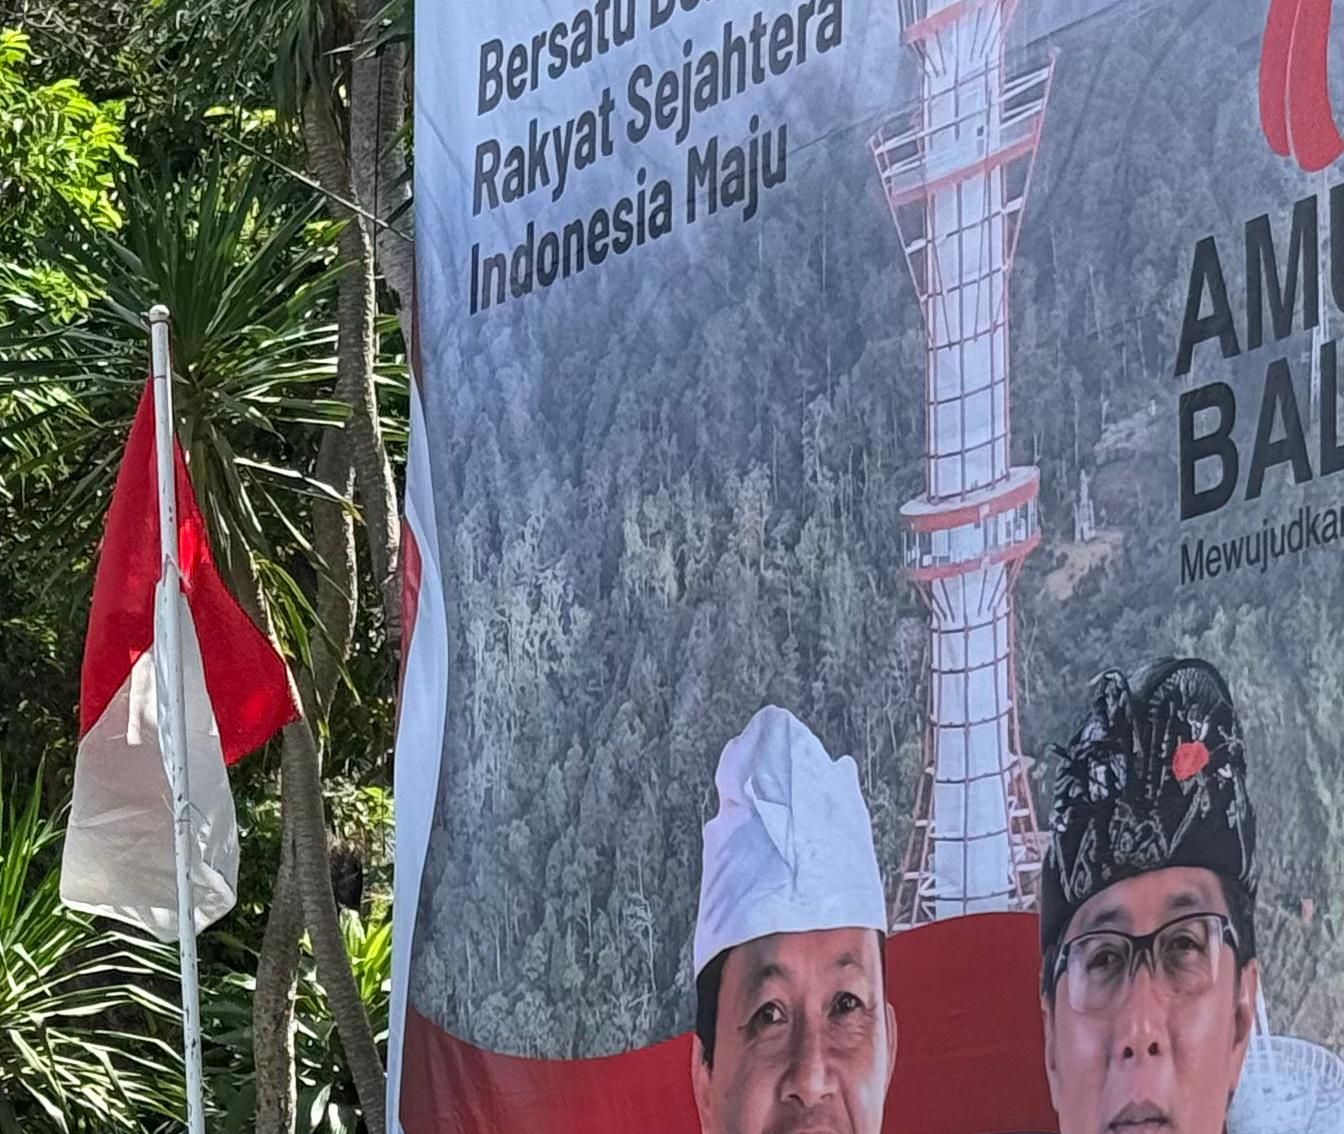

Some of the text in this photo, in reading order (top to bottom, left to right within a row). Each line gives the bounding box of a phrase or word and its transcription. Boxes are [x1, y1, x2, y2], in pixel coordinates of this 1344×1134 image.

[473, 0, 843, 218] Rakyat Sejahtera
[477, 0, 635, 117] Bersatu
[469, 114, 789, 316] Indonesia Maju
[1174, 183, 1344, 378] AM
